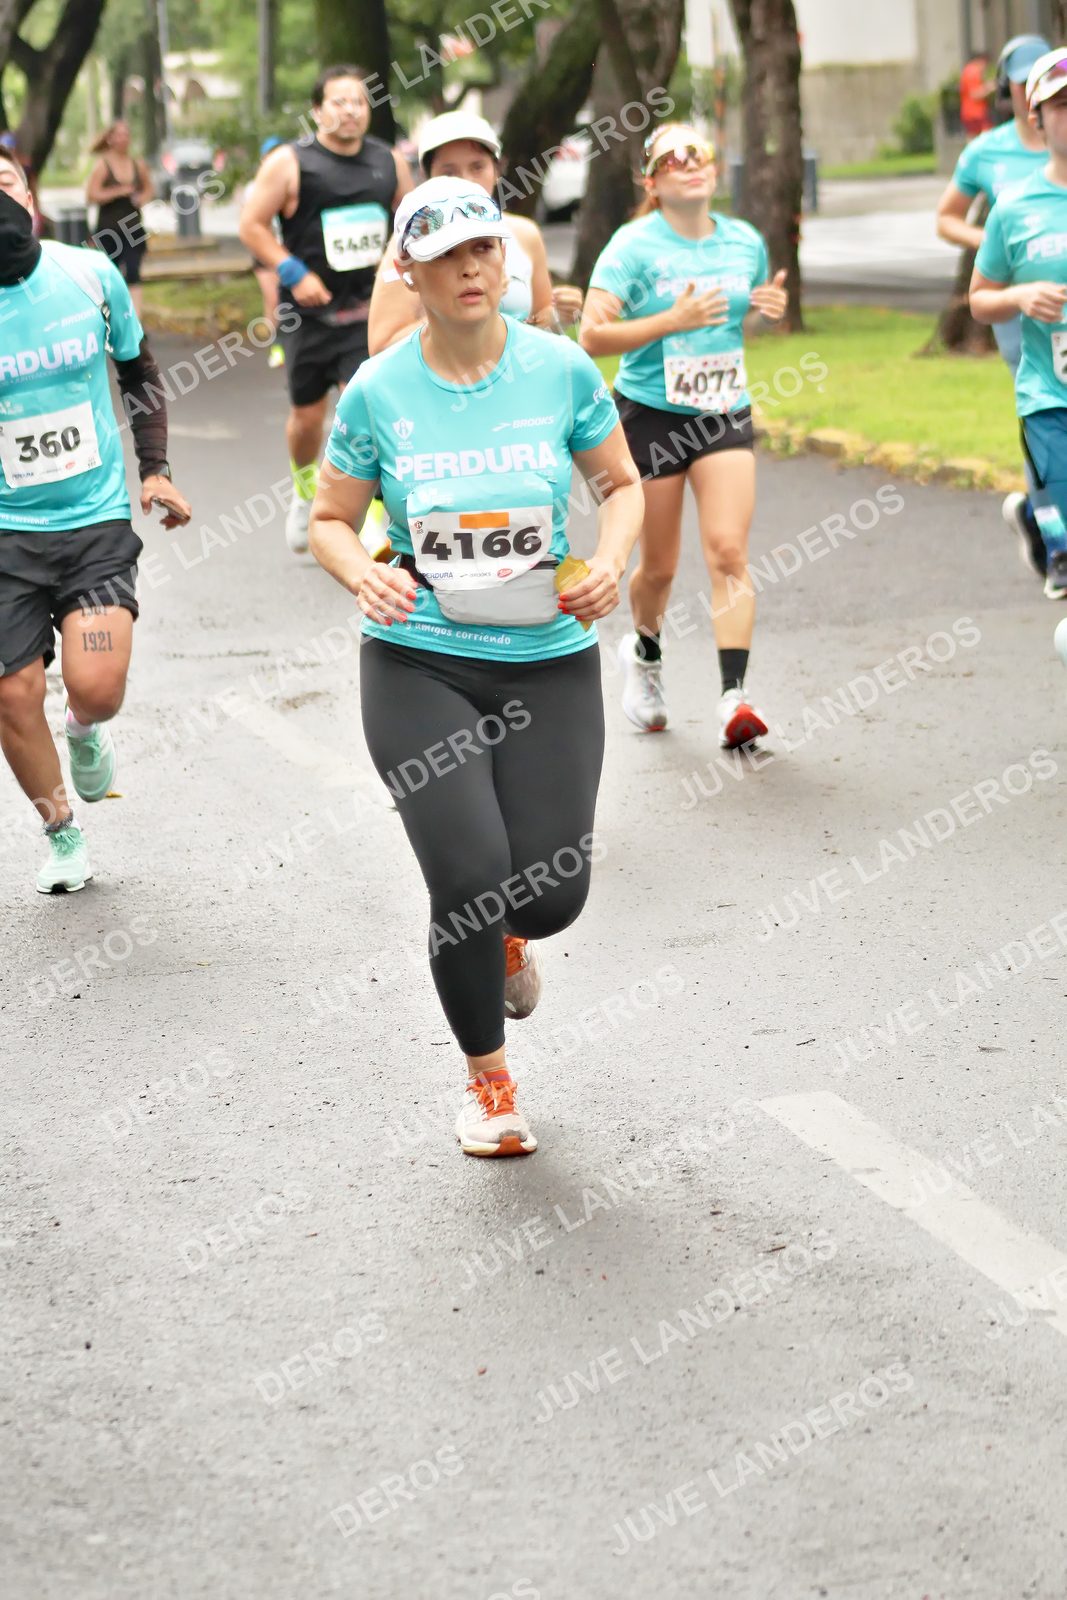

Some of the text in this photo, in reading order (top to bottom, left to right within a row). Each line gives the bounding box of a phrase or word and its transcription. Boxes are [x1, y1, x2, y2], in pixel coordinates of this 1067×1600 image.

[674, 368, 741, 395] 4072
[512, 415, 555, 429] BROOKS
[15, 426, 81, 463] 360
[394, 440, 559, 483] PERDURA
[421, 526, 543, 560] 4166
[82, 631, 113, 652] 1921
[415, 622, 452, 638] amigos
[455, 628, 511, 645] corriendo
